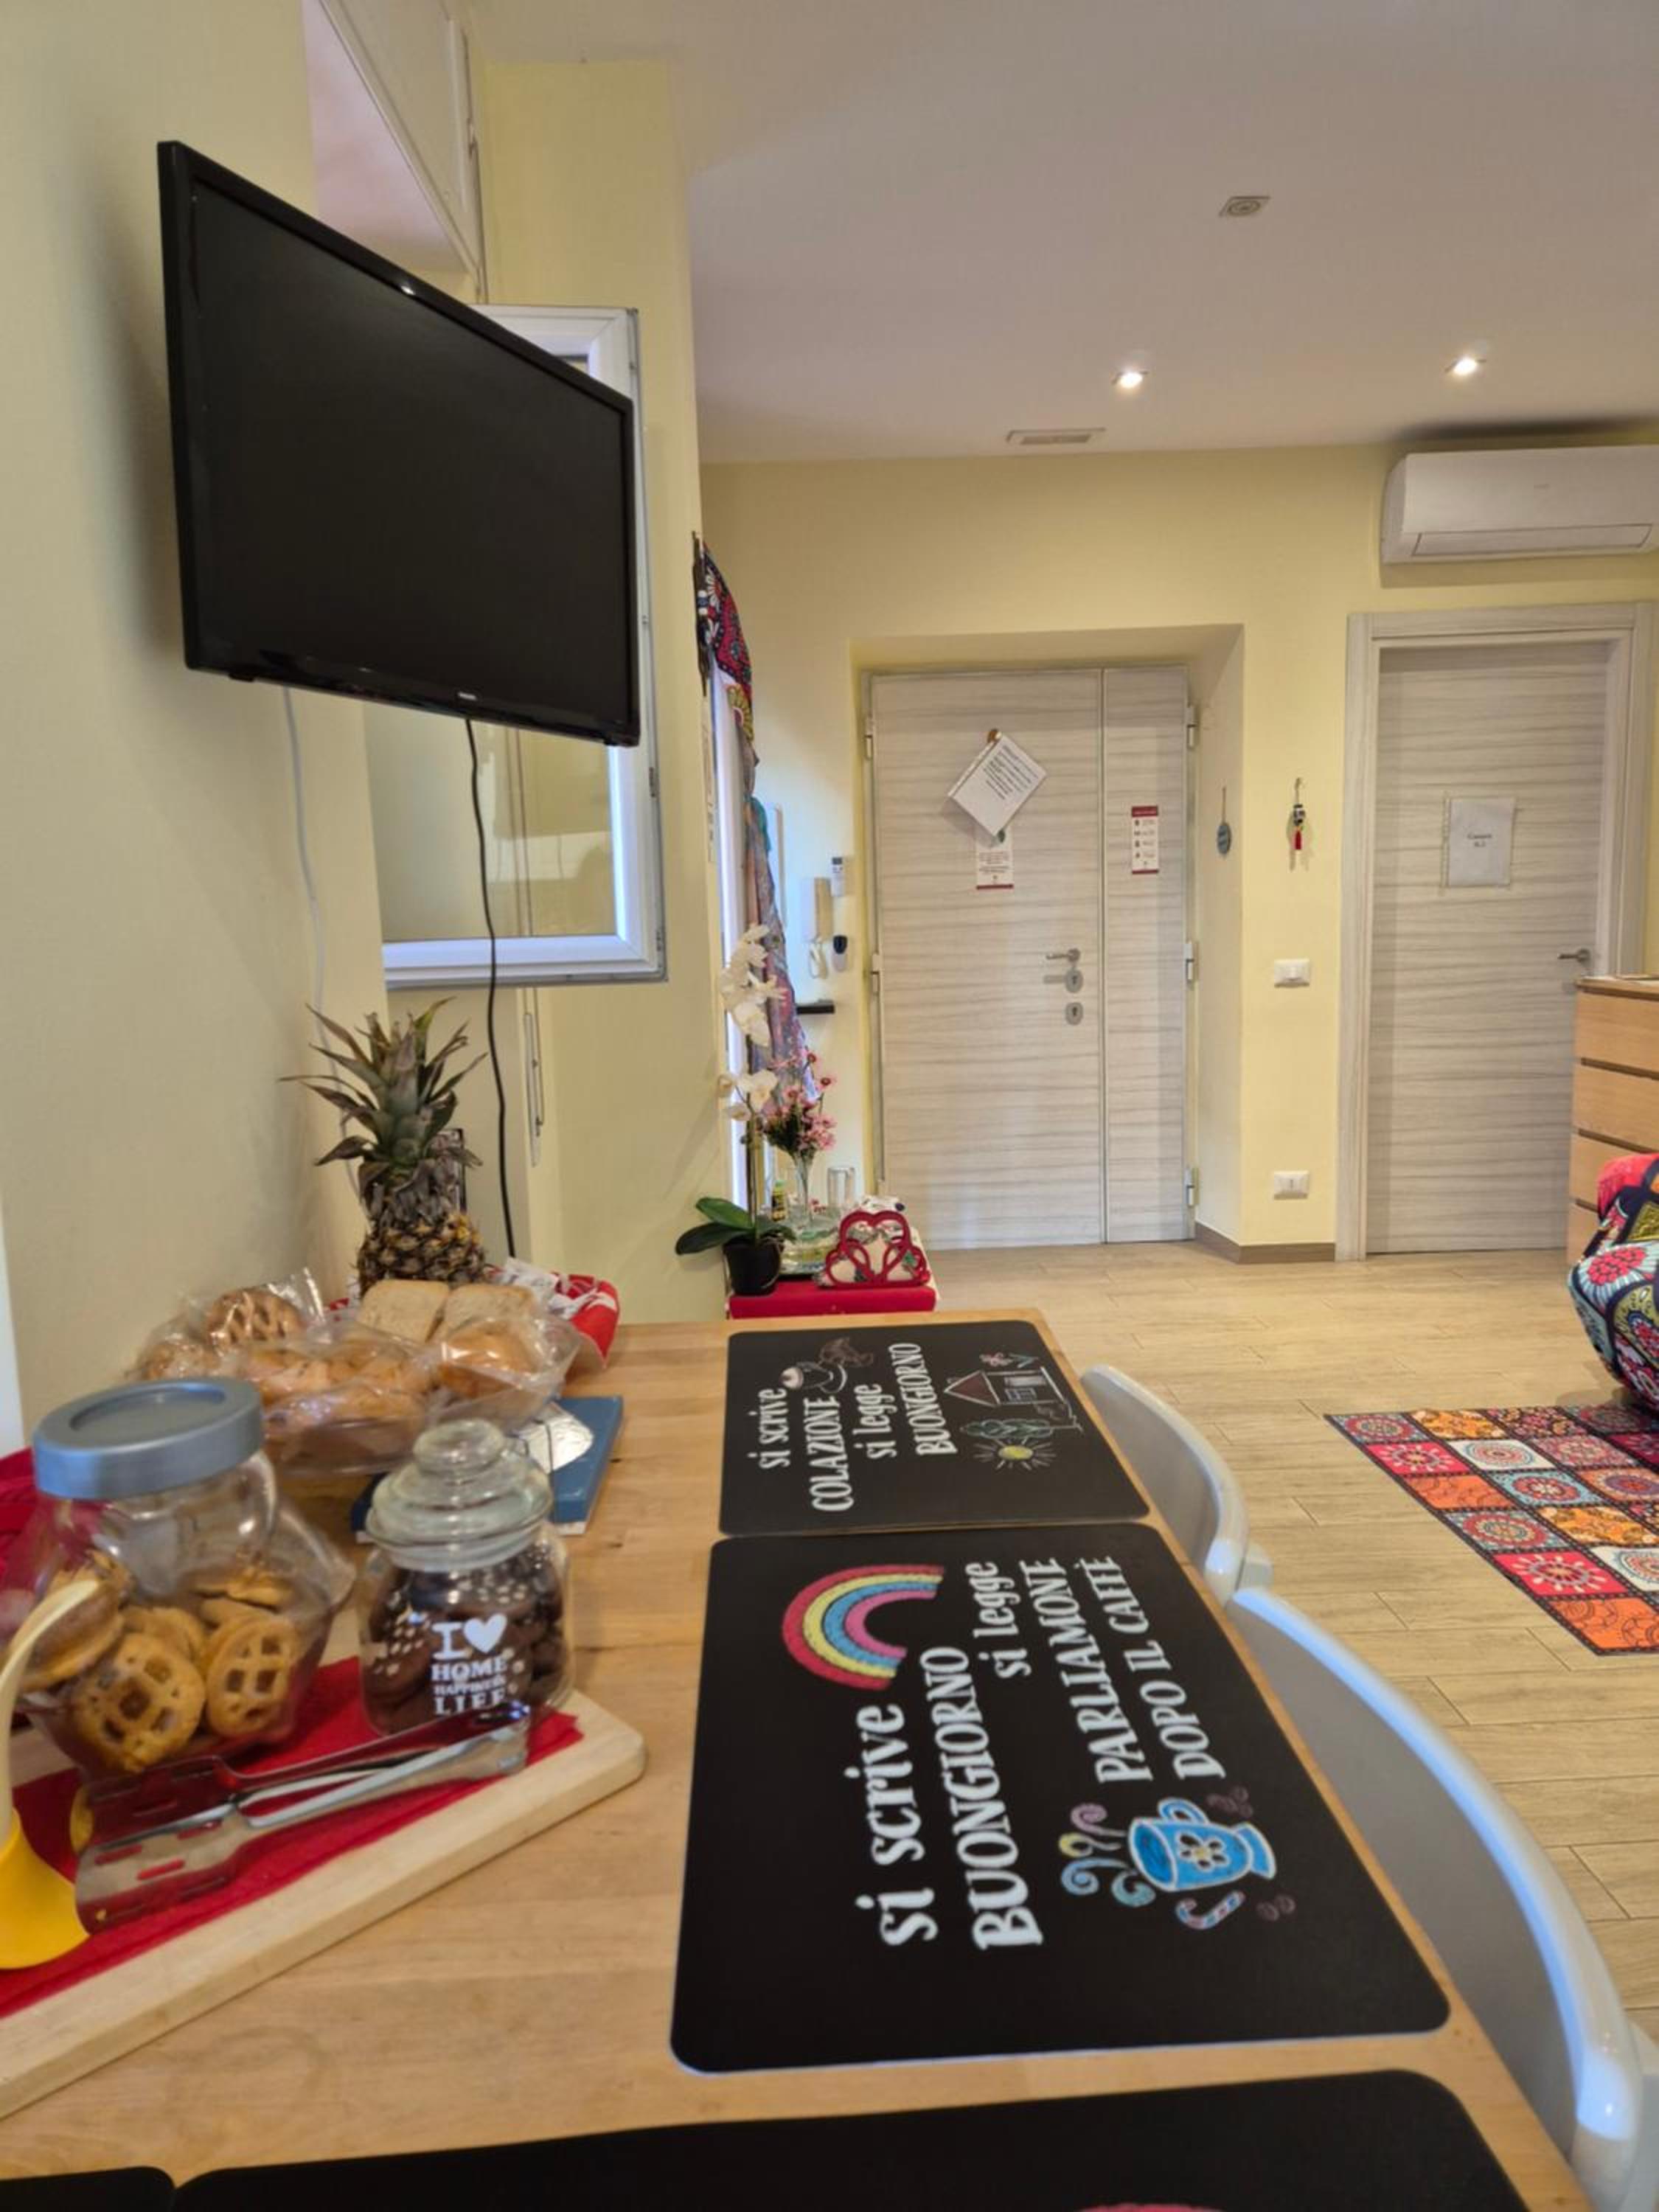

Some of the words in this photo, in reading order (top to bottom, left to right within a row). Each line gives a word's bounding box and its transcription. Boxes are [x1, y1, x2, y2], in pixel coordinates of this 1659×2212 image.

[748, 1388, 789, 1444] scrive
[852, 1383, 897, 1435] legge
[888, 1343, 958, 1455] BUONGIORNO
[748, 1450, 790, 1469] si
[803, 1396, 854, 1512] COLAZIONE
[853, 1441, 897, 1459] si
[965, 1562, 1020, 1638] legge
[1074, 1556, 1150, 1635] CAFFÈ
[431, 1622, 470, 1660] I
[431, 1657, 507, 1681] HOME
[978, 1648, 1032, 1679] si
[1123, 1640, 1172, 1672] IL
[1018, 1557, 1153, 1784] PARLIAMONE
[1139, 1680, 1225, 1780] DOPO
[844, 1703, 925, 1865] scrive
[919, 1646, 1043, 1950] BUONGIORNO
[855, 1888, 939, 1946] si
